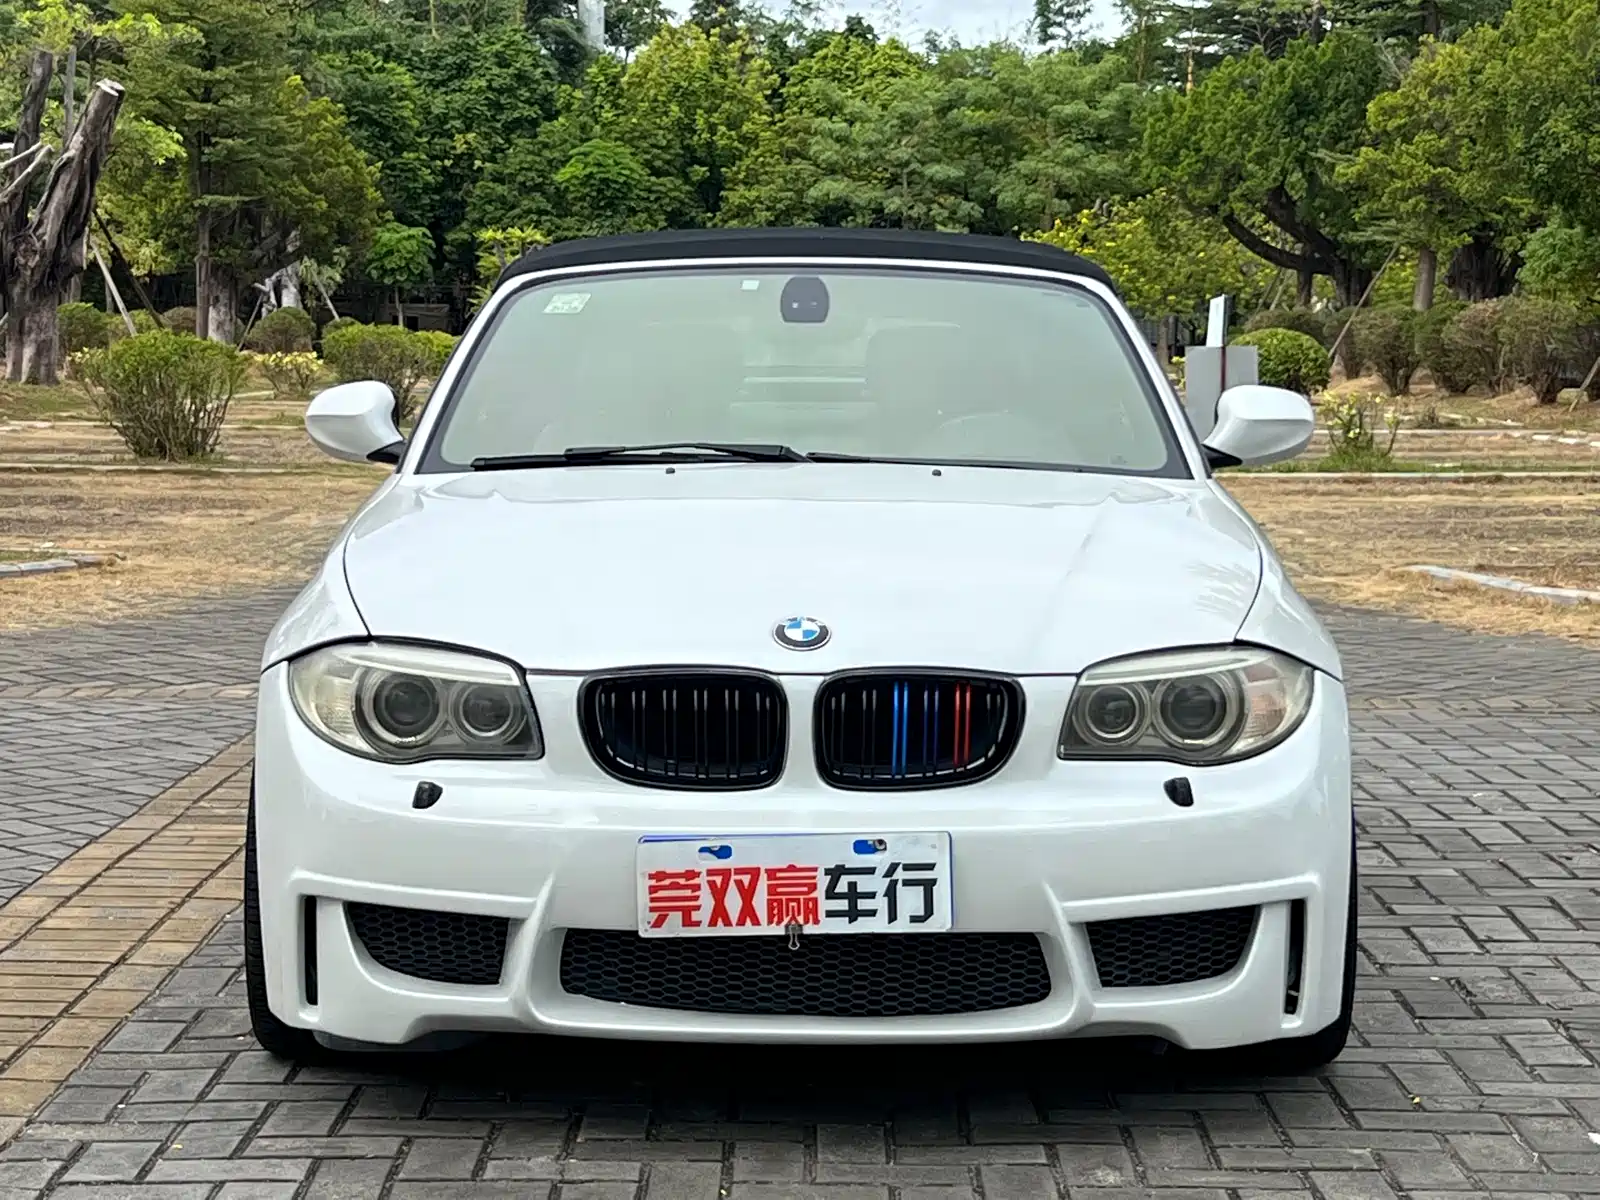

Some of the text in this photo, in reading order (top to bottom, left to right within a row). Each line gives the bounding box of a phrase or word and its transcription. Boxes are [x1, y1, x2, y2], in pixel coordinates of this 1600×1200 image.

[647, 862, 938, 928] 莞双赢车行
